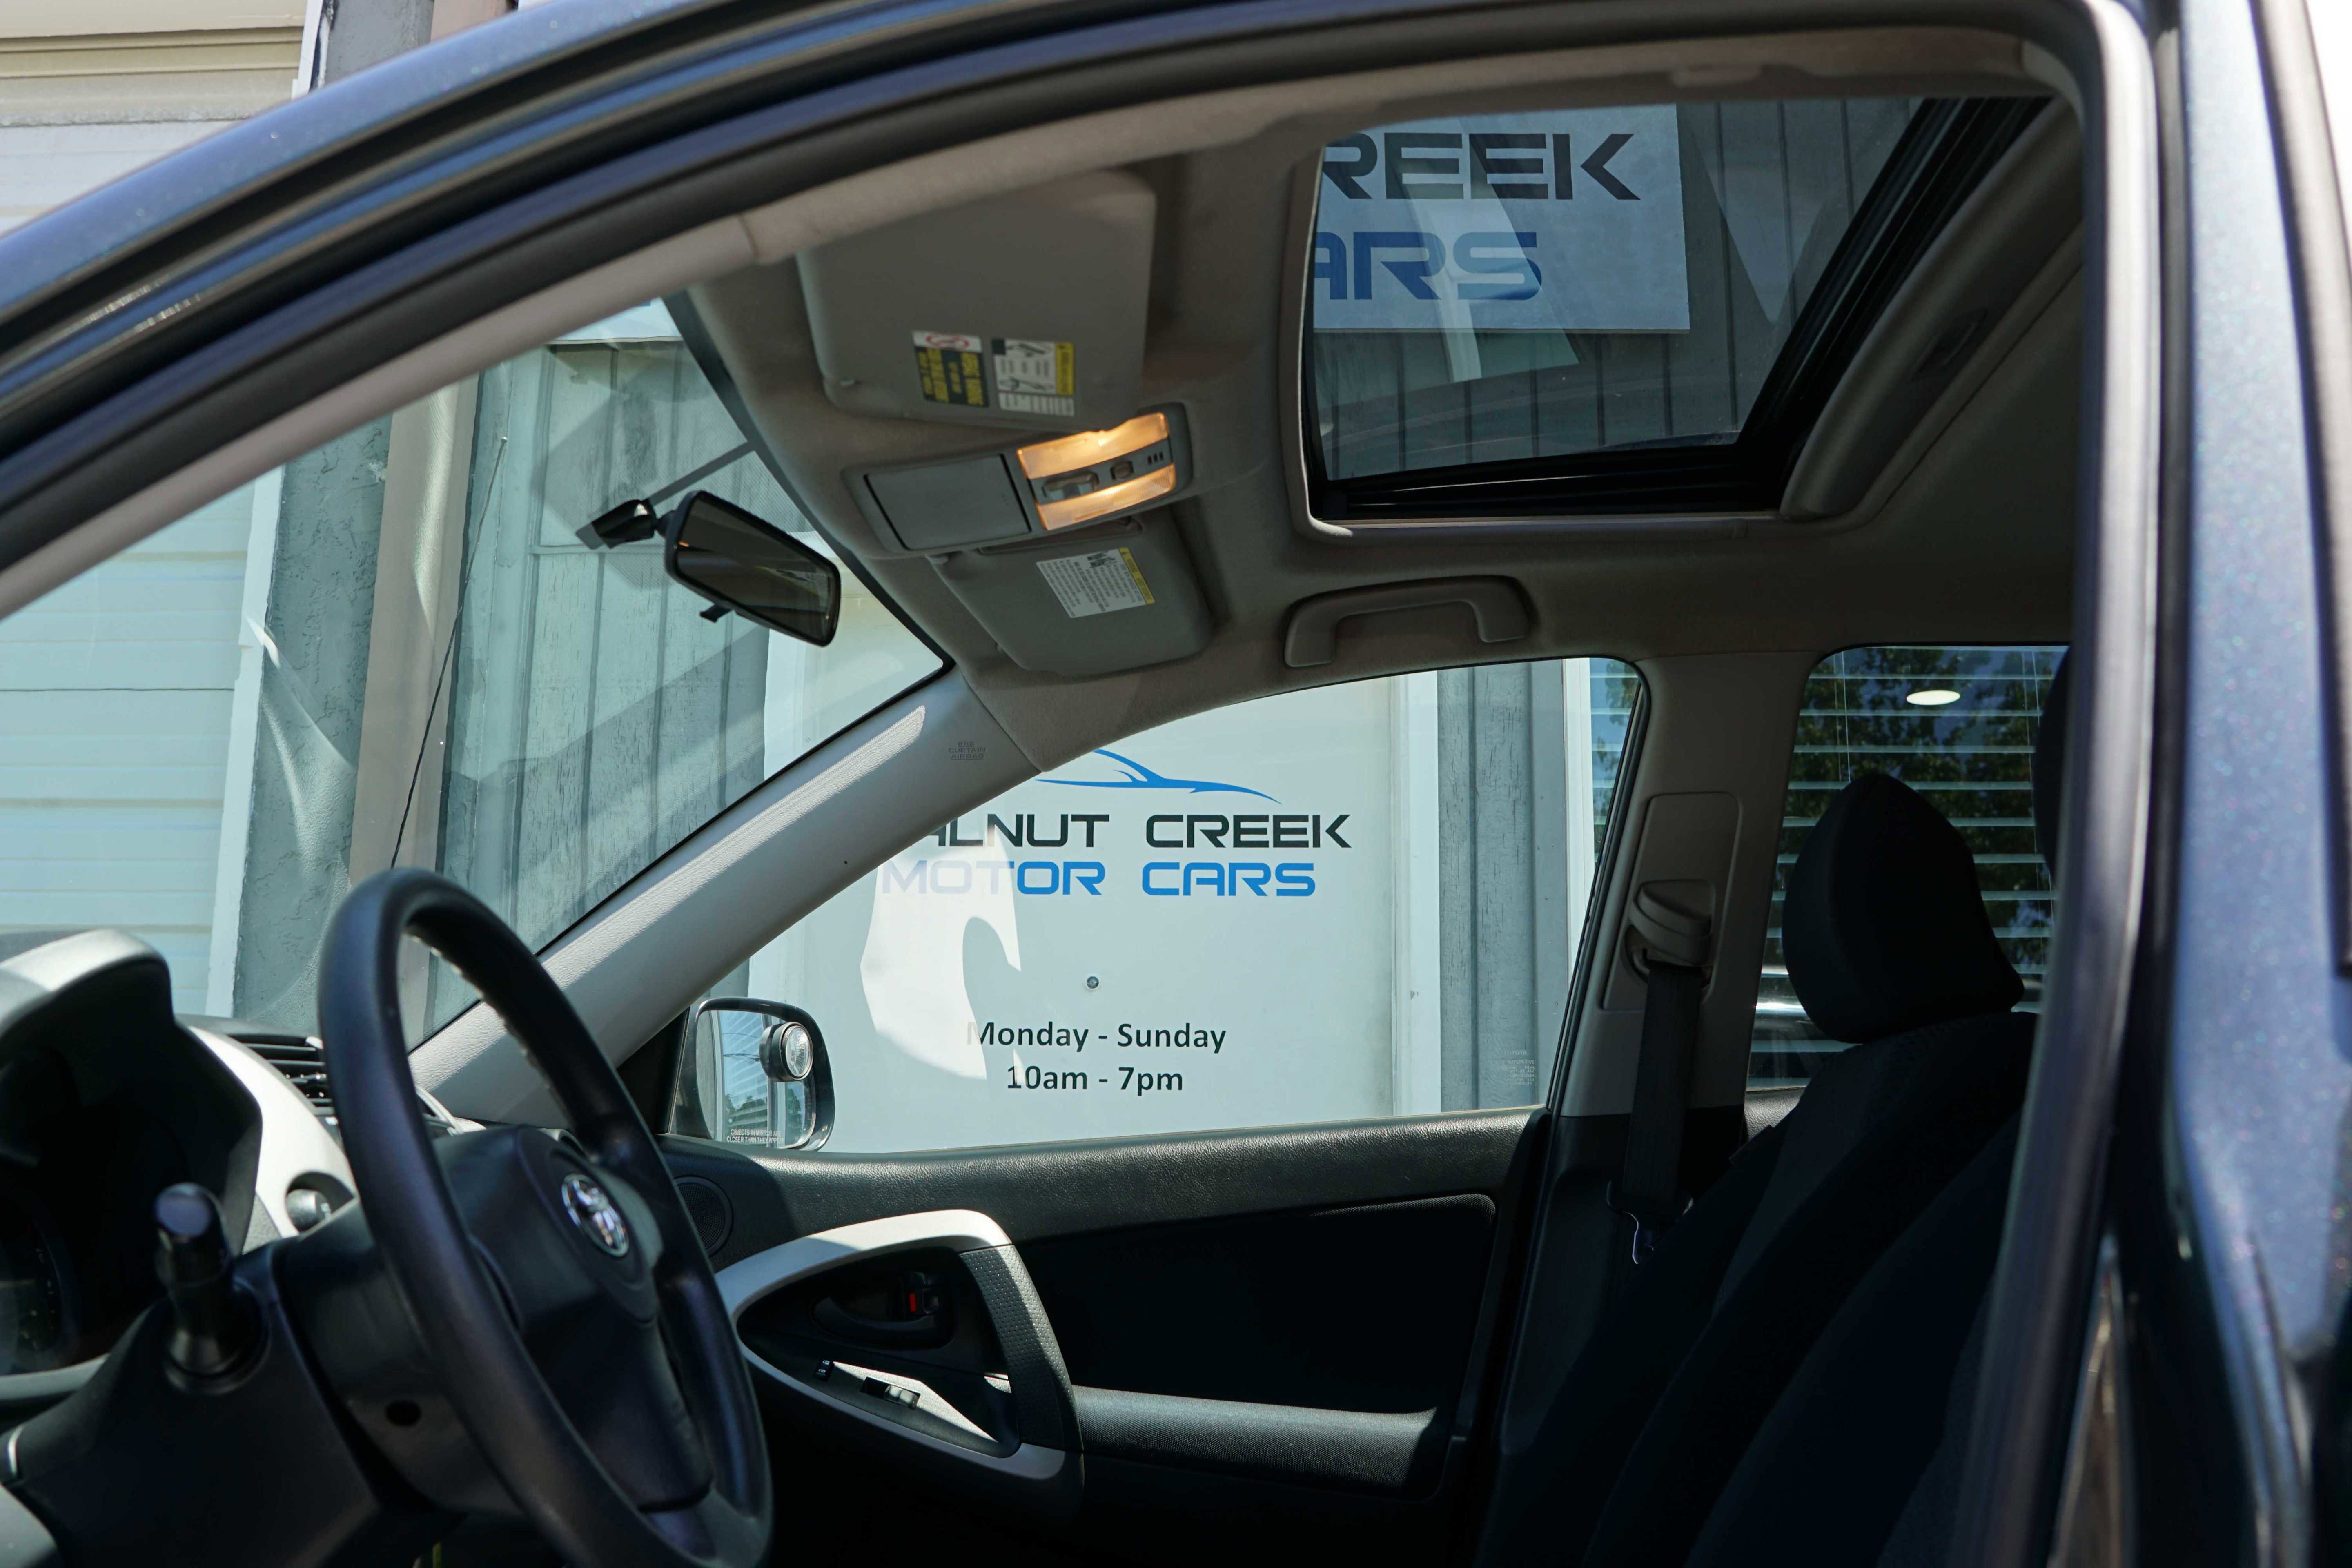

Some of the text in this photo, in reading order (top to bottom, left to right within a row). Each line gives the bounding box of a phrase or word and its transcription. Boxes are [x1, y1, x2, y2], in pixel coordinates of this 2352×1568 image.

[1146, 814, 1352, 848] CREEK
[881, 860, 1316, 896] MOTOR CARS
[967, 1021, 1089, 1052] Monday
[1117, 1023, 1227, 1054] Sunday
[1007, 1065, 1087, 1090] 10am
[1118, 1067, 1183, 1096] 7pm
